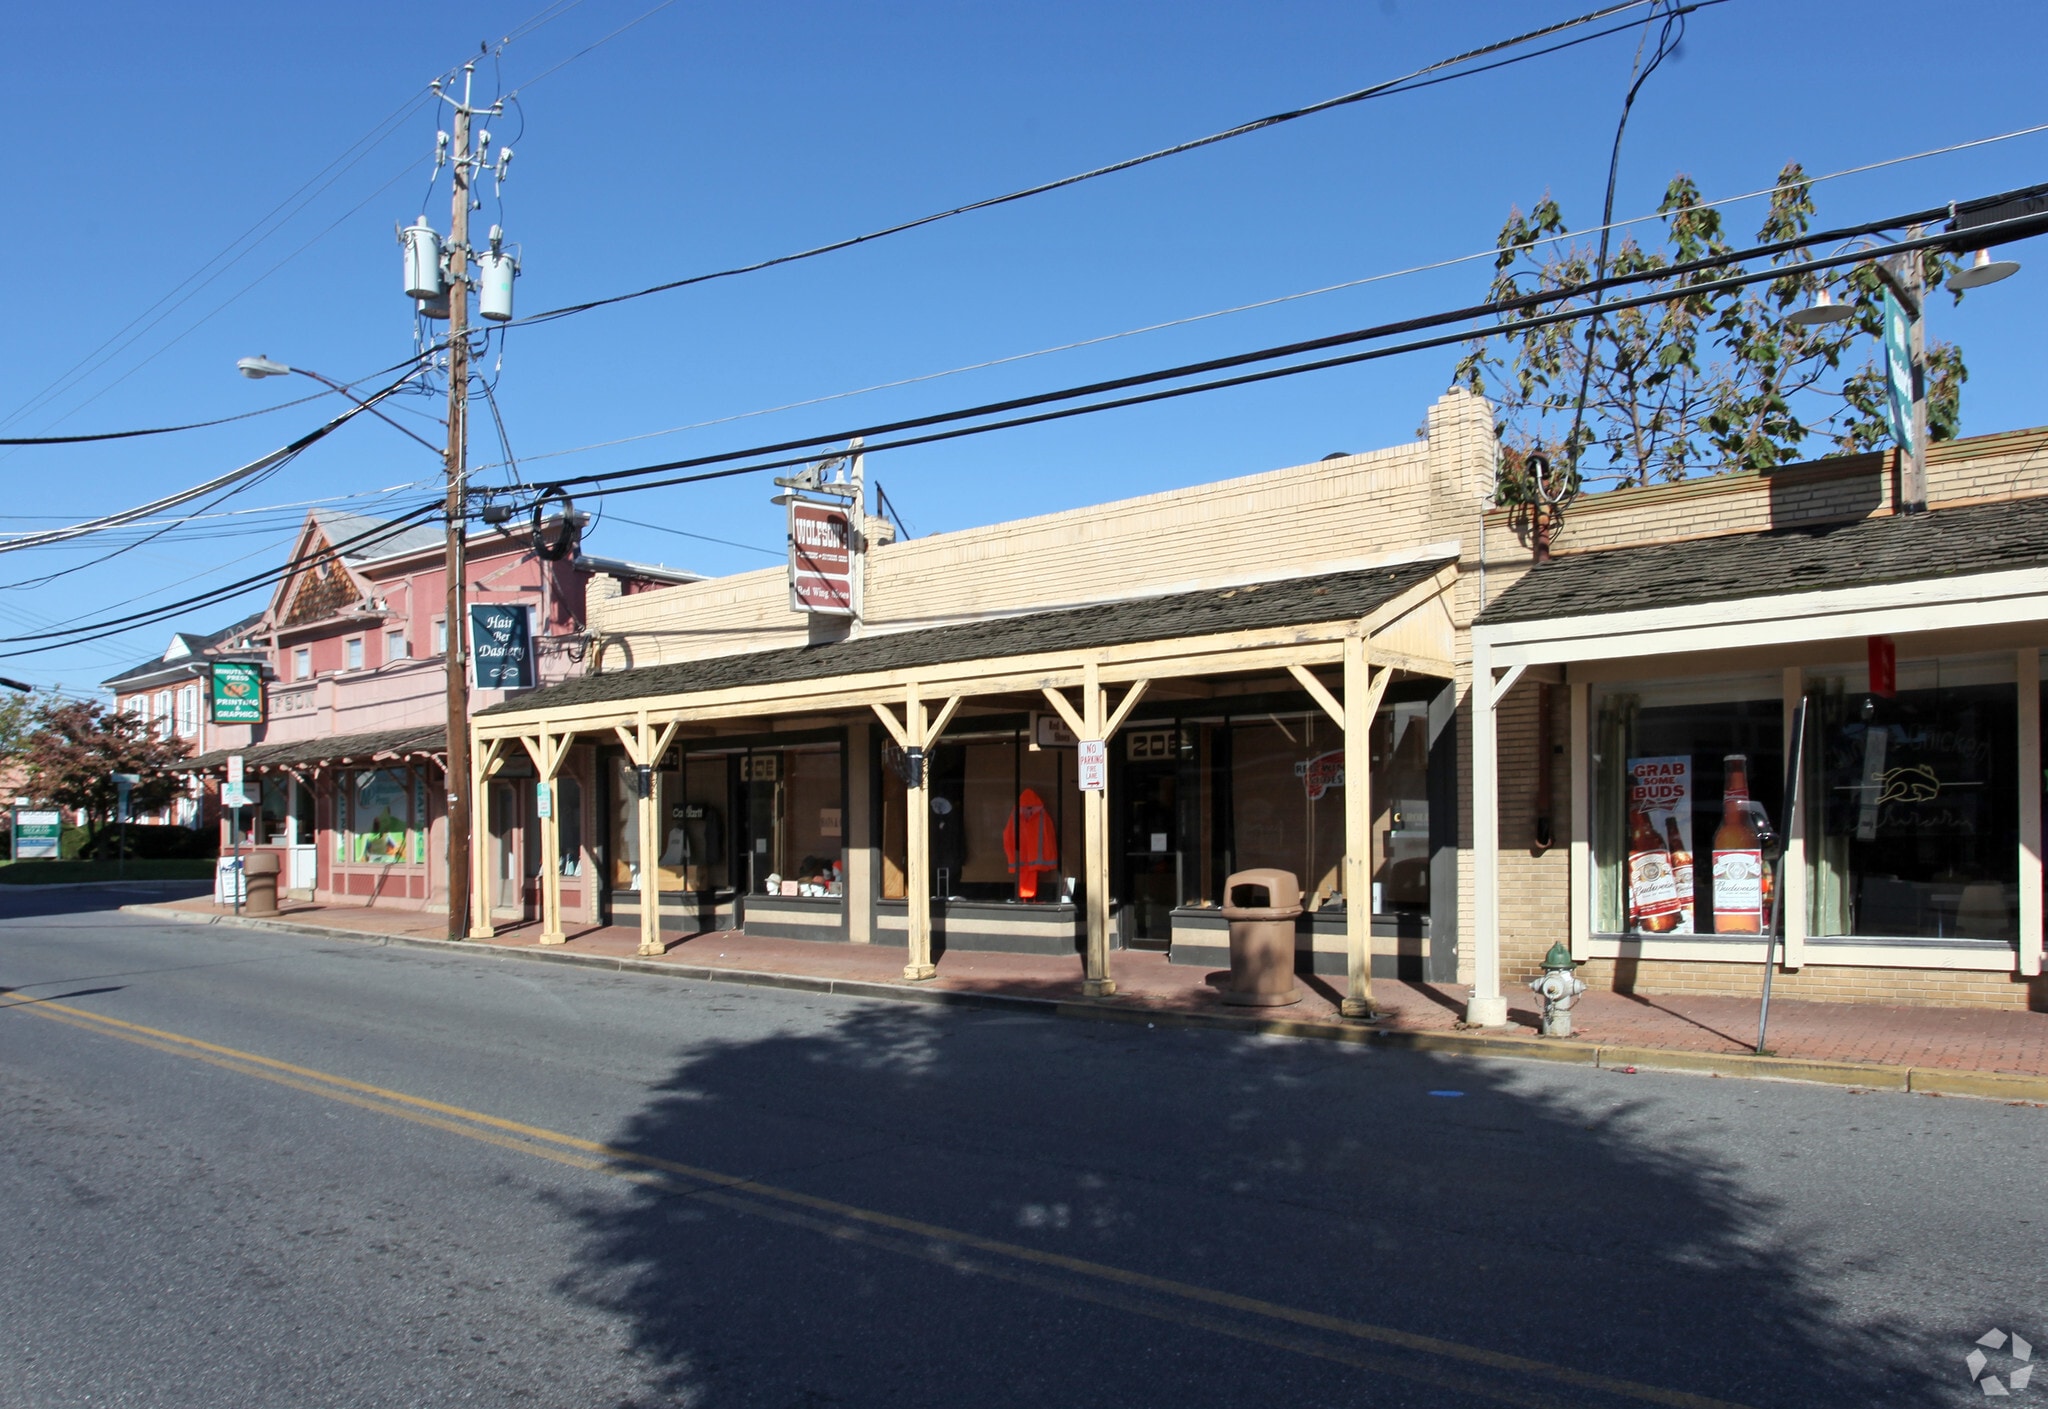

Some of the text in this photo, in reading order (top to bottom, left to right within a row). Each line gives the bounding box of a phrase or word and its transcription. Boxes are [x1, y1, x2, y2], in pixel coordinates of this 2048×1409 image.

[797, 585, 811, 597] Red
[812, 587, 830, 600] Wing
[486, 614, 514, 629] Hair
[493, 631, 511, 642] Ber
[478, 643, 525, 662] Dashery
[216, 698, 259, 706] PRINTING
[1086, 743, 1097, 754] NO
[1080, 755, 1104, 764] PARKING
[1633, 763, 1685, 777] GRAB
[1643, 776, 1676, 785] SOME
[1634, 785, 1685, 798] BUDS
